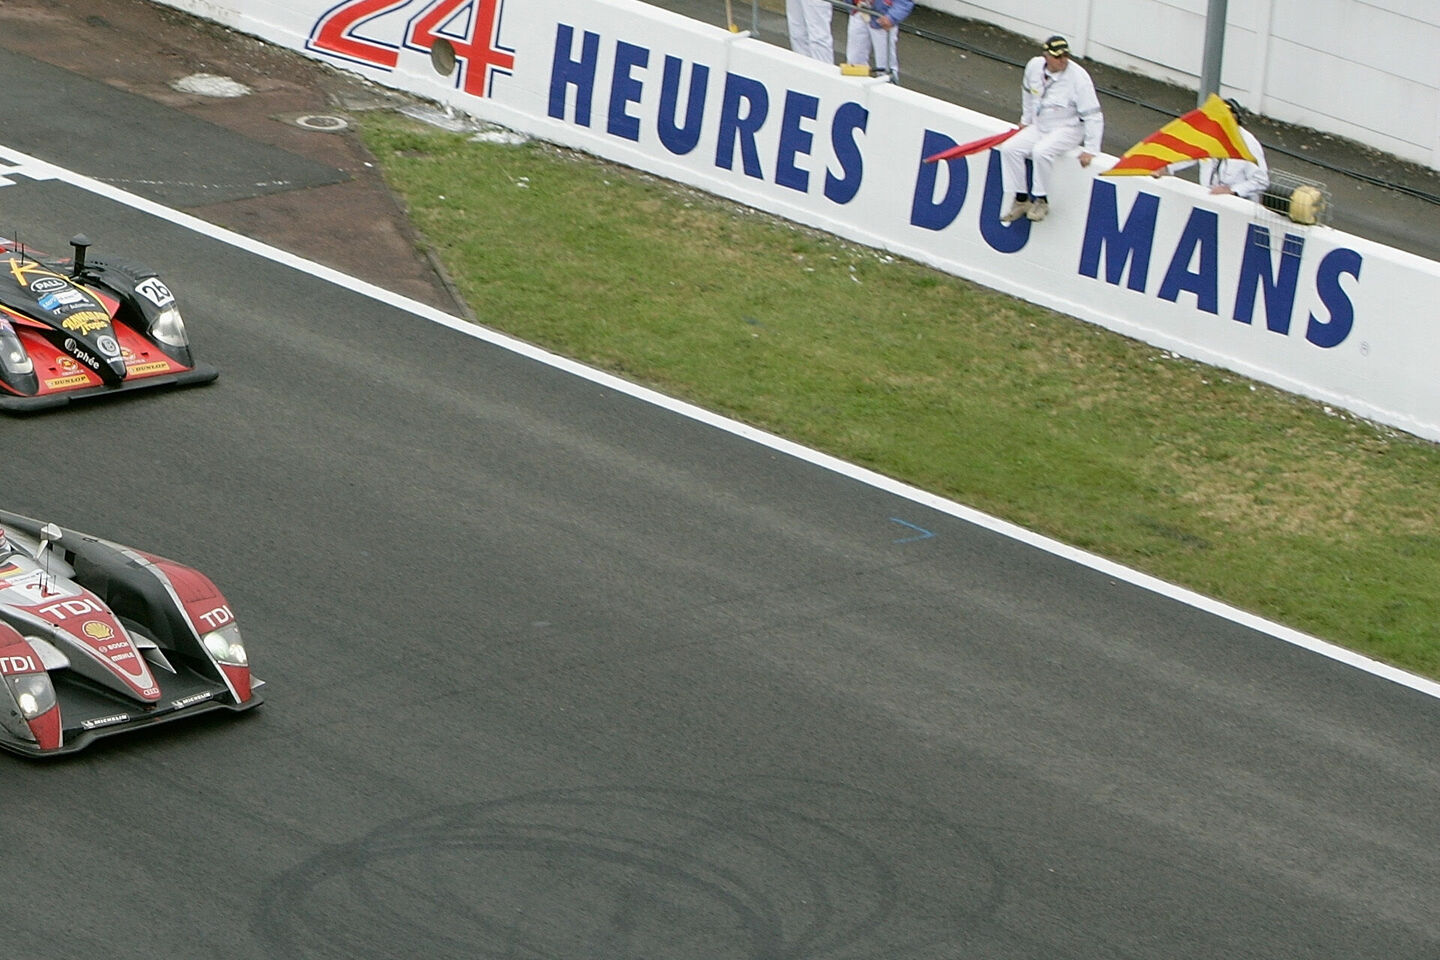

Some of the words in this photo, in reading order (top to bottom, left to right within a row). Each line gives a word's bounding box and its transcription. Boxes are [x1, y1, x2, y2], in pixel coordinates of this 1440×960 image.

[548, 23, 869, 205] HEURES
[1078, 178, 1363, 349] MANS
[142, 281, 170, 303] 26
[135, 363, 167, 372] DUNLOP
[54, 375, 86, 386] DUNLOP
[26, 583, 61, 598] 2
[39, 598, 103, 620] TDI
[199, 605, 234, 627] TDI
[108, 641, 129, 651] BOSCH
[111, 652, 136, 661] MAHLE
[181, 692, 212, 707] MICHELIN
[93, 714, 127, 727] MICHELIN
